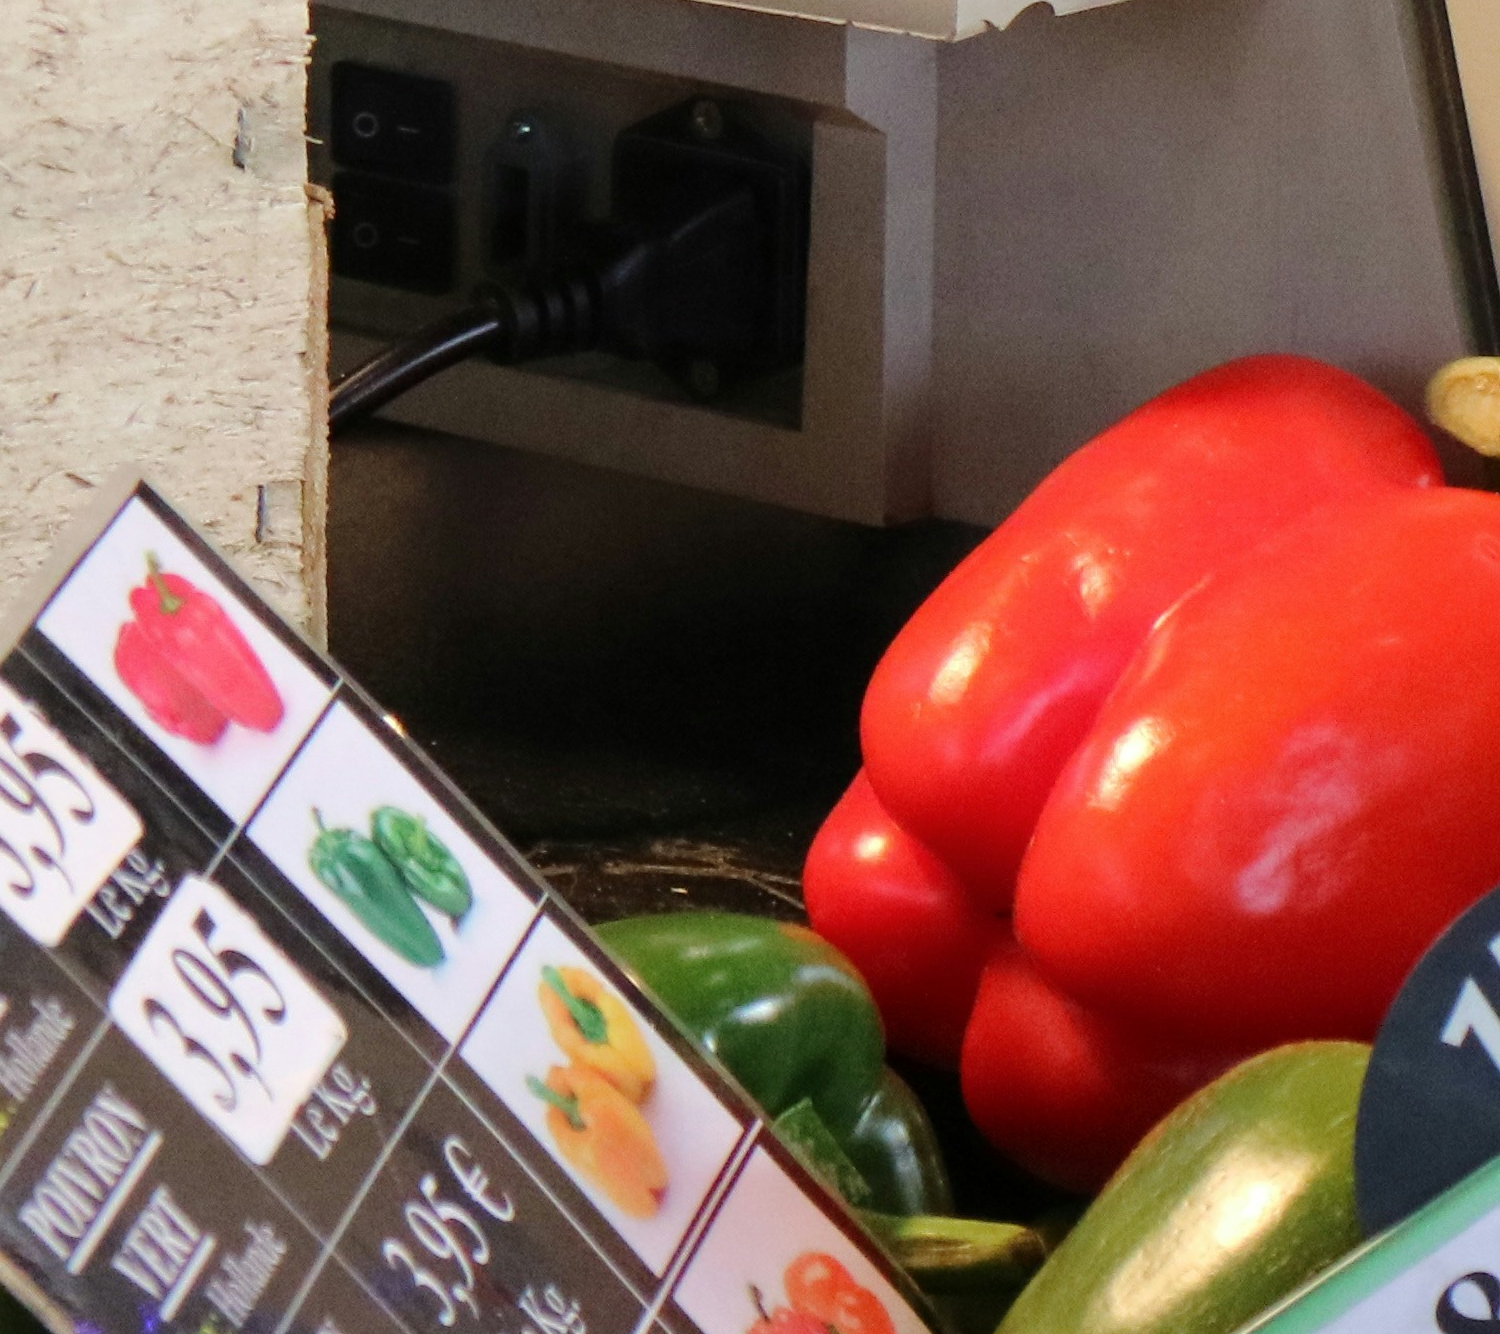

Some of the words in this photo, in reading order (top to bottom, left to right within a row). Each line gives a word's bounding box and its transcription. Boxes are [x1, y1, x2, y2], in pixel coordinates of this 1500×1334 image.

[142, 907, 287, 1113] 3,95
[18, 1080, 149, 1260] POIVRON
[110, 1182, 202, 1301] VERT
[383, 1173, 490, 1328] 3,95
[443, 1135, 515, 1223] €
